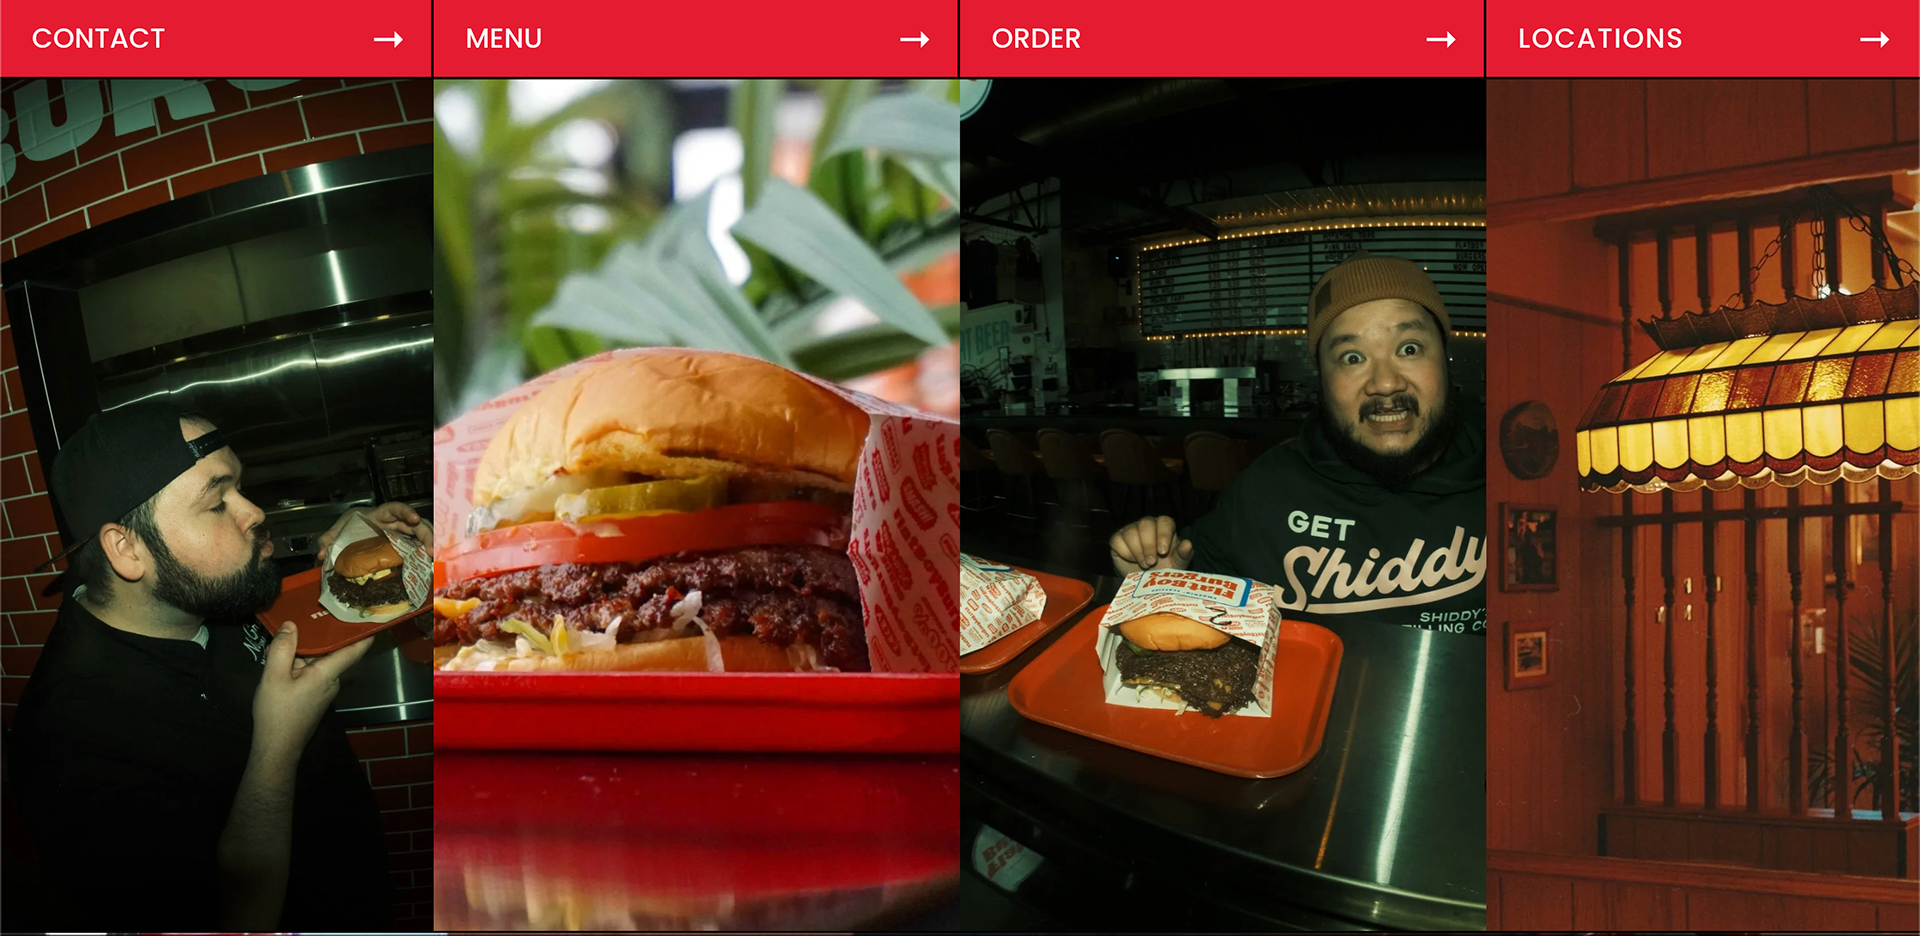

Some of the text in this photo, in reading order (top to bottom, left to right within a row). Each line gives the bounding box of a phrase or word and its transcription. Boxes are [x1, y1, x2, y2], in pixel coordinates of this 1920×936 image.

[1324, 241, 1362, 251] PINK SAILS
[1455, 241, 1484, 250] FLATBOY
[1453, 263, 1468, 271] NOW
[975, 320, 1011, 355] BEER
[902, 480, 934, 523] SMASH!
[1287, 510, 1355, 541] GET
[1272, 525, 1486, 614] Shiddy
[1142, 577, 1236, 600] FlatBoy
[1148, 571, 1238, 590] Burgers
[1419, 608, 1486, 623] SHIDDY'
